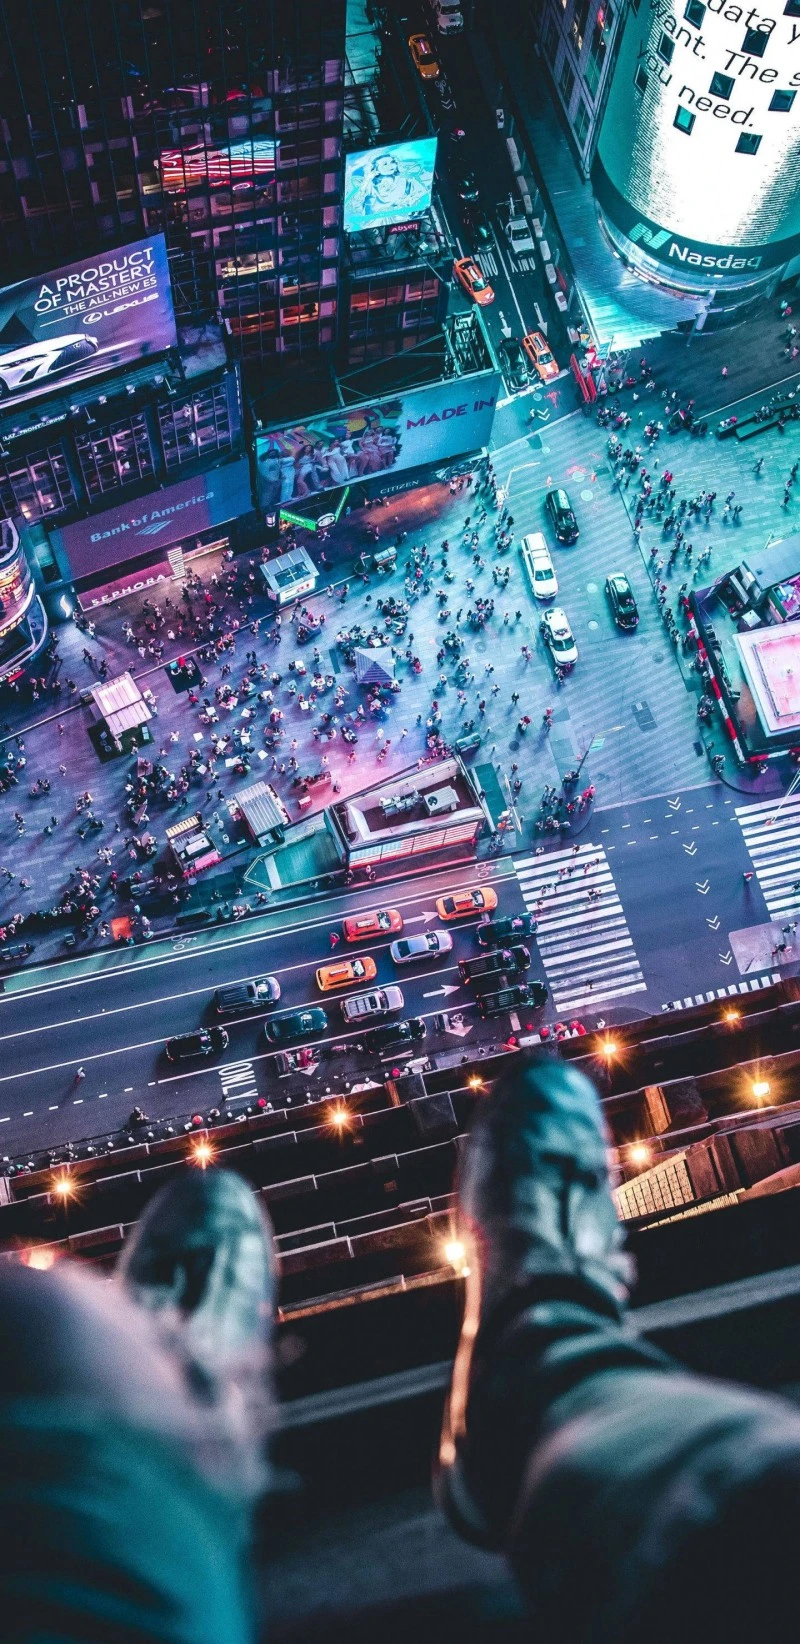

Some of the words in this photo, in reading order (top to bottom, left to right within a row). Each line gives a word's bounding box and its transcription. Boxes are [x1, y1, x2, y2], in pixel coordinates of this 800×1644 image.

[706, 0, 777, 35] data
[637, 40, 673, 87] you
[678, 85, 754, 127] need.
[725, 49, 778, 83] The
[38, 284, 53, 298] A
[57, 247, 153, 293] PRODUCT
[668, 243, 763, 269] Nasdaq
[34, 296, 62, 313] OF
[67, 260, 155, 302] MASTERY
[63, 302, 87, 316] THE
[89, 284, 141, 307] ALL-NEW
[143, 276, 157, 288] ES
[104, 292, 159, 316] LEXUS
[407, 403, 468, 430] MADE
[474, 396, 495, 412] IN
[380, 480, 419, 494] CITIZEN
[90, 523, 130, 543] Bank
[133, 514, 149, 528] of
[151, 490, 215, 520] America
[91, 574, 167, 606] SEPHORA
[218, 1062, 259, 1101] ONLY
